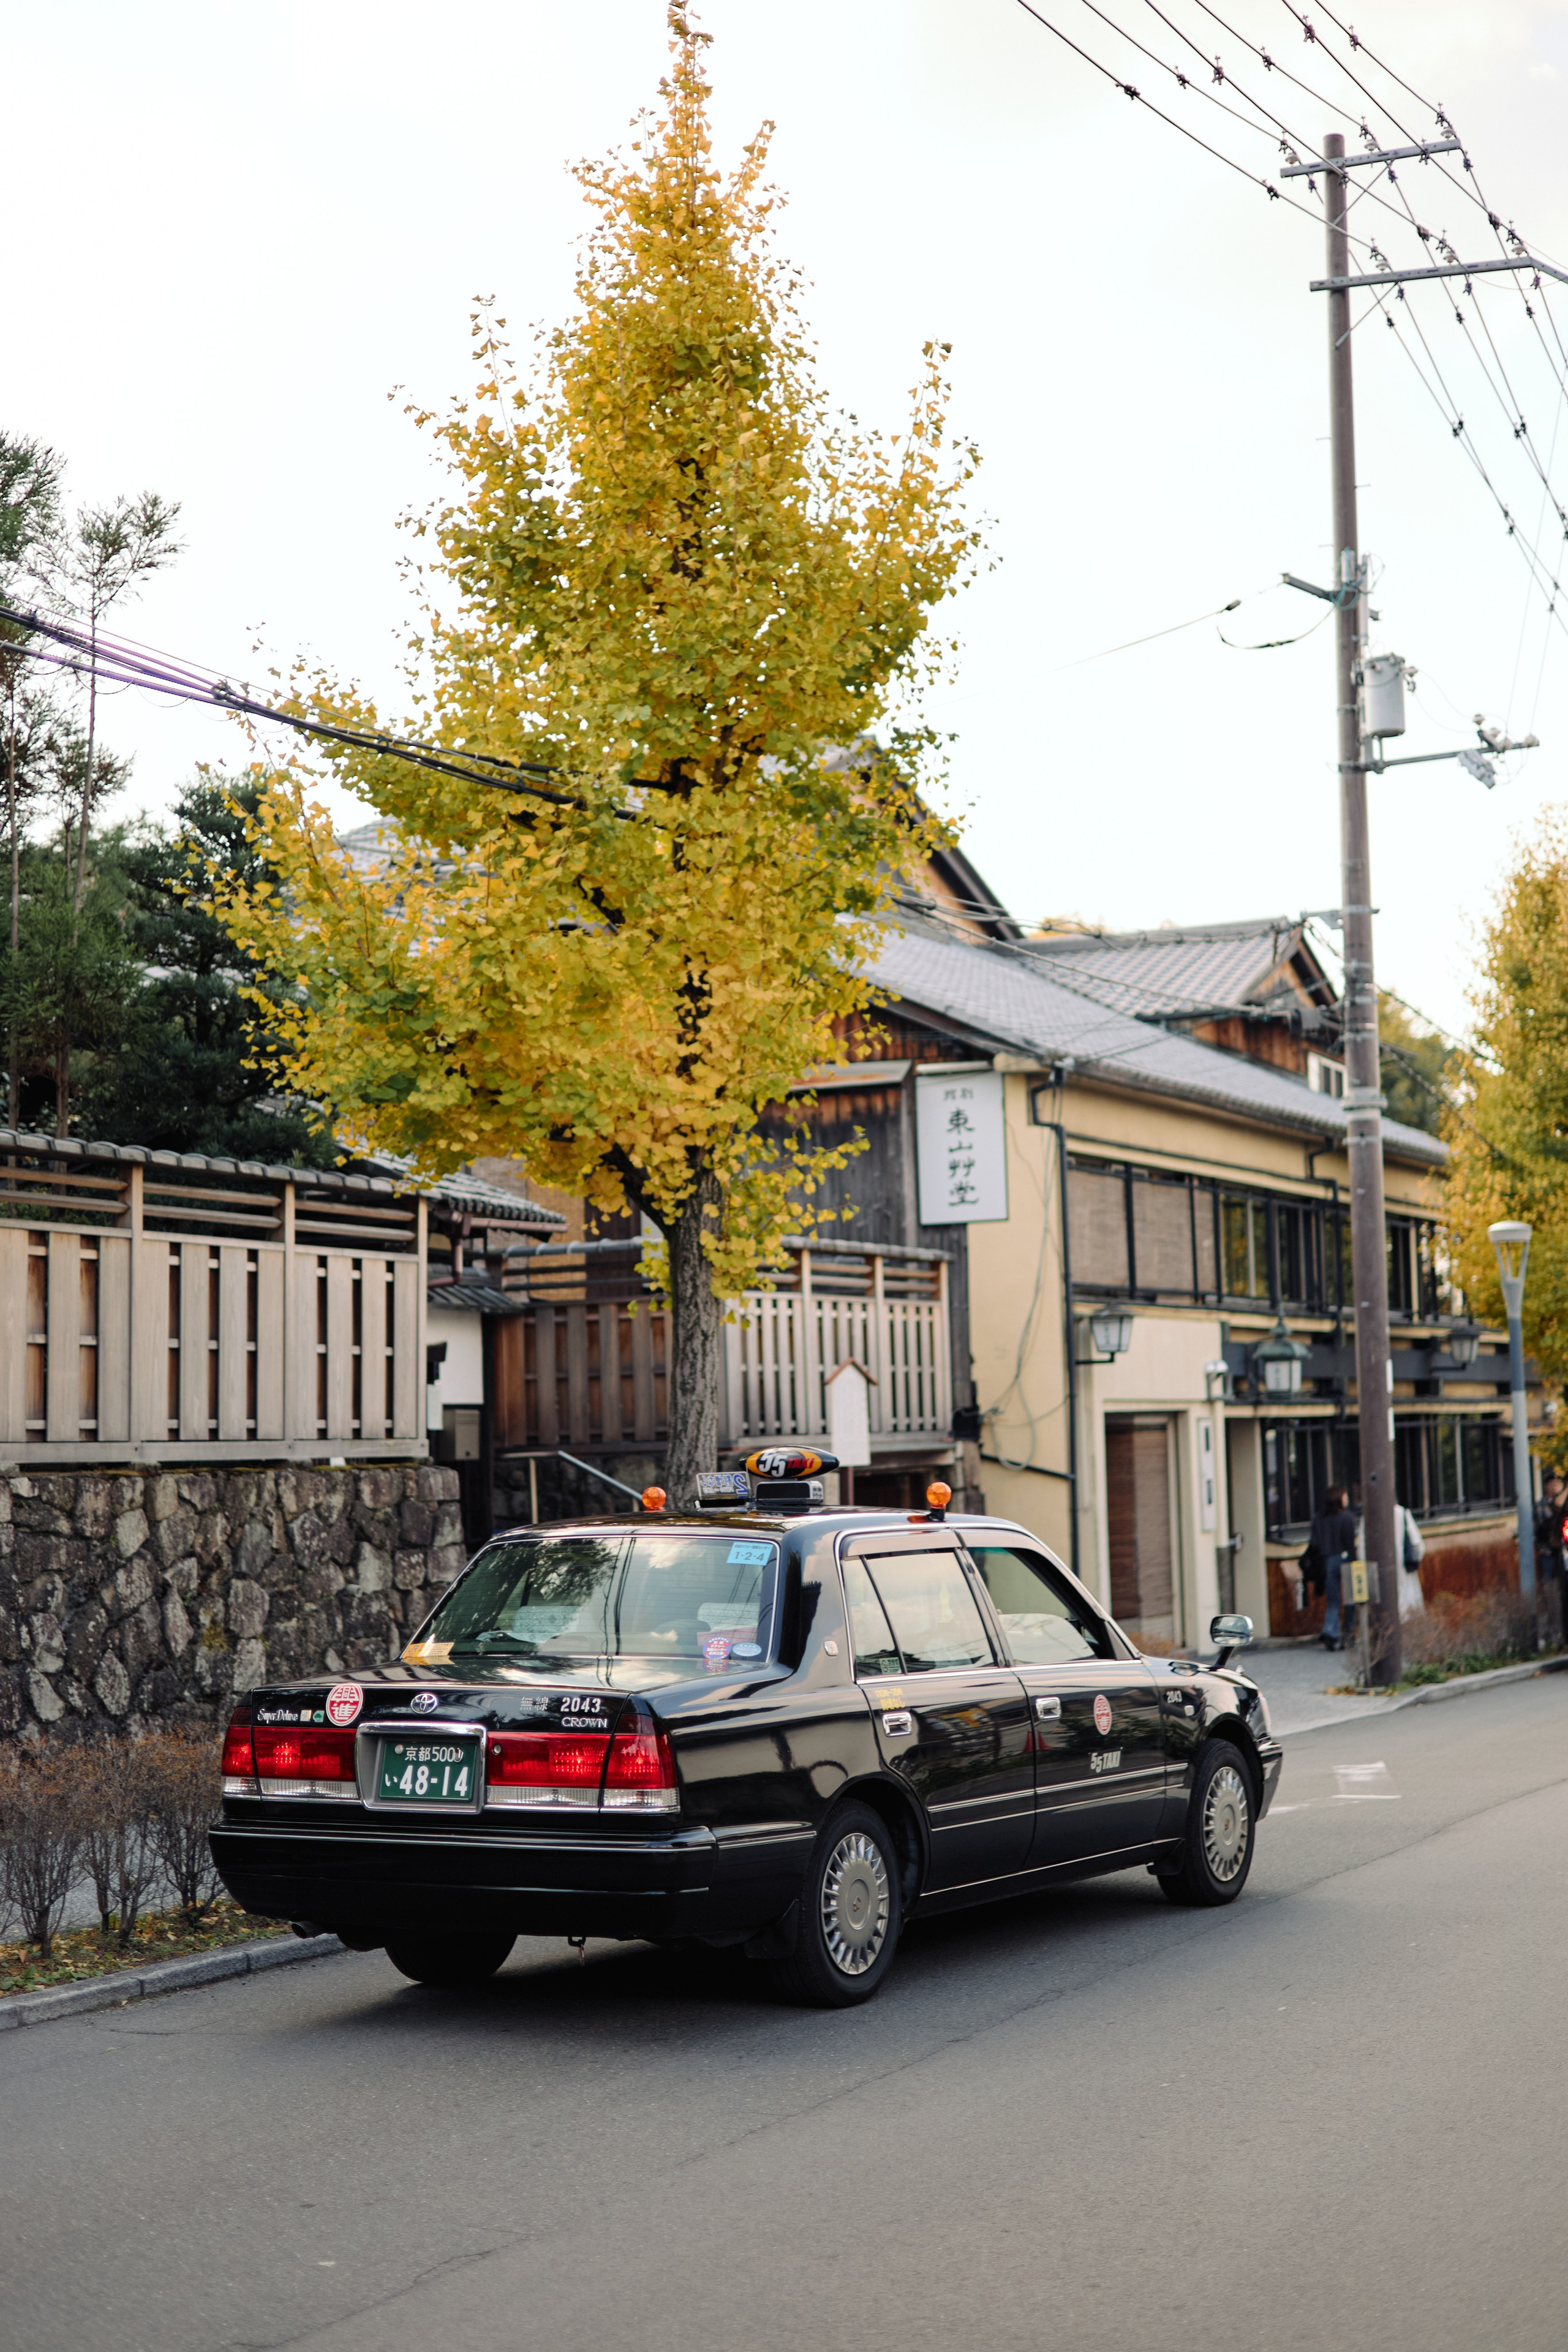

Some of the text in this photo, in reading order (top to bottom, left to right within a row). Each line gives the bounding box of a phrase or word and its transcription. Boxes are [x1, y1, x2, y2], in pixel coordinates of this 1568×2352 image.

[758, 1450, 815, 1477] 55 TAXI
[519, 1697, 601, 1713] 無線 2043
[1166, 1690, 1183, 1703] 2043
[561, 1717, 608, 1728] CROWN
[1090, 1751, 1121, 1773] 55 TAXI
[385, 1765, 469, 1796] い 48-14
